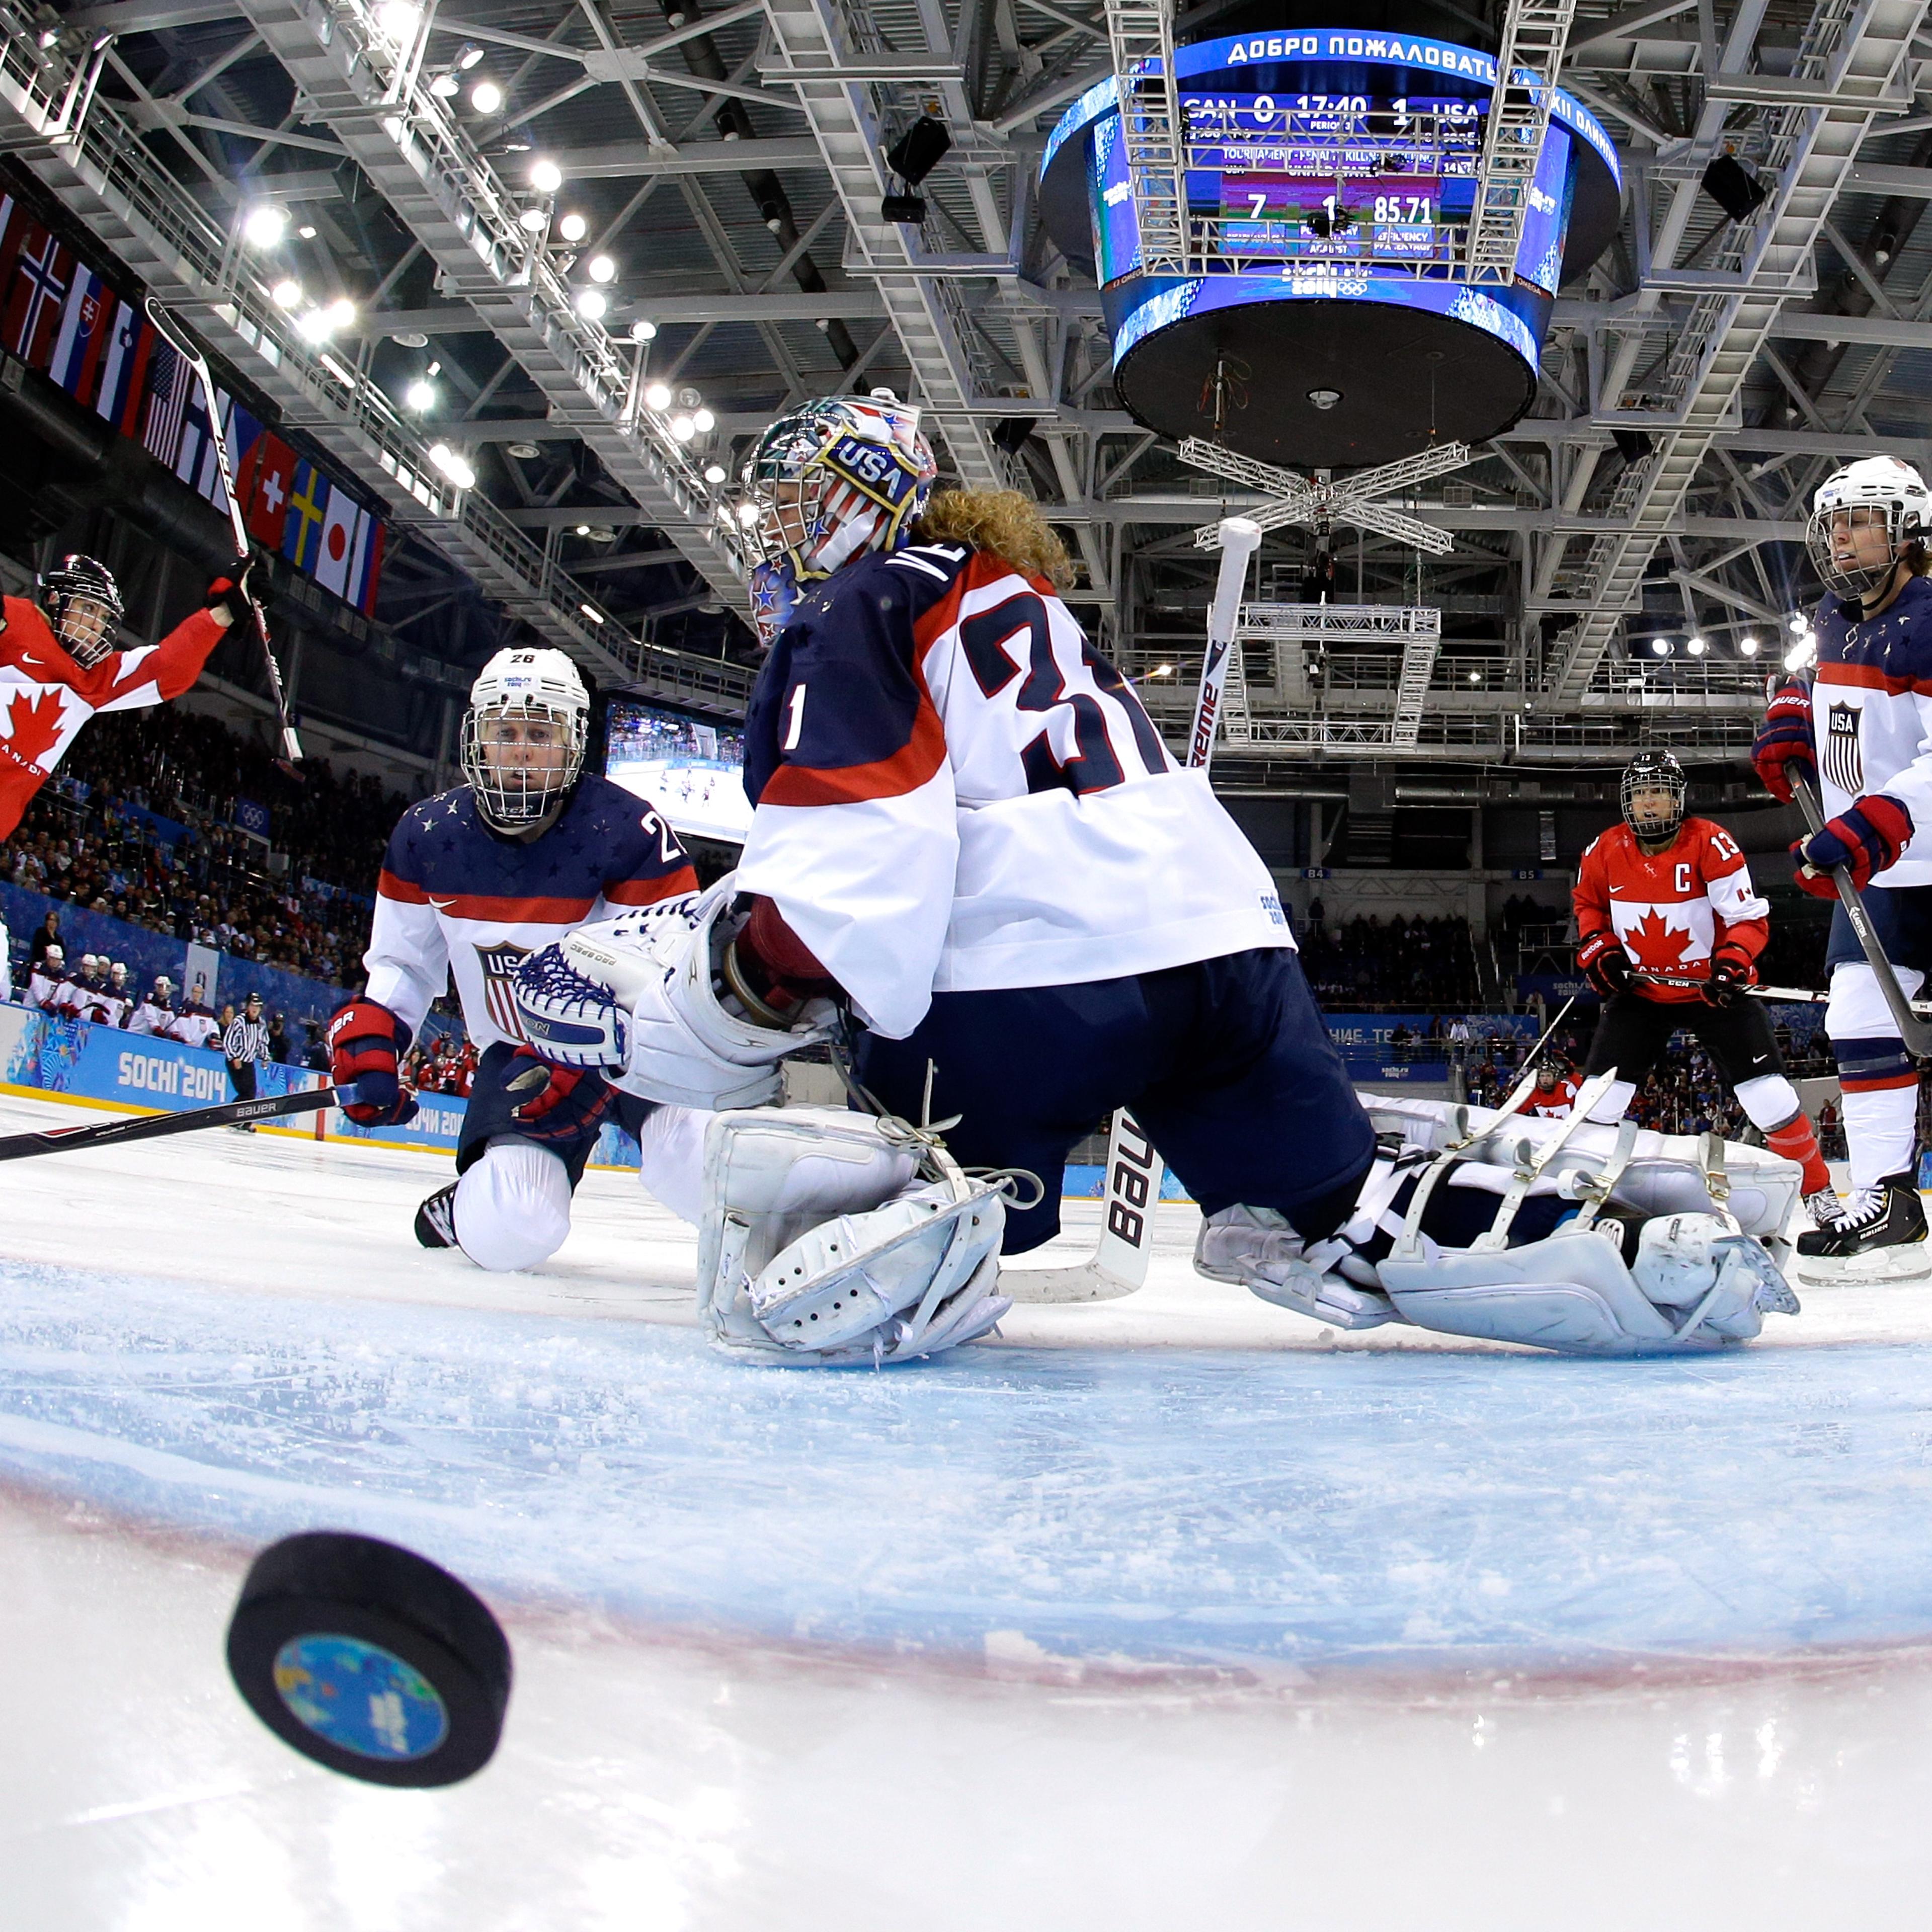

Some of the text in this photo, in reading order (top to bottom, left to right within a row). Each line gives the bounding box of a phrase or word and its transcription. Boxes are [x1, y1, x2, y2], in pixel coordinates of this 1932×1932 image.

[1228, 37, 1318, 64] ДОБРО
[1183, 95, 1479, 125] CAN 0 17:40 1 USA
[1248, 194, 1266, 218] 7
[1322, 195, 1336, 220] 1
[1374, 196, 1432, 223] 85.71
[1517, 278, 1542, 295] OMEGA
[838, 439, 903, 499] USA
[510, 655, 535, 664] 26
[1832, 712, 1854, 733] USA
[641, 811, 688, 863] 2
[1711, 832, 1740, 861] 13
[1674, 863, 1691, 893] C
[488, 954, 520, 975] US
[1638, 960, 1702, 973] ANADA
[118, 1052, 226, 1103] SOCHI 2014
[236, 1102, 277, 1117] BAUER
[1108, 1116, 1154, 1249] BAU
